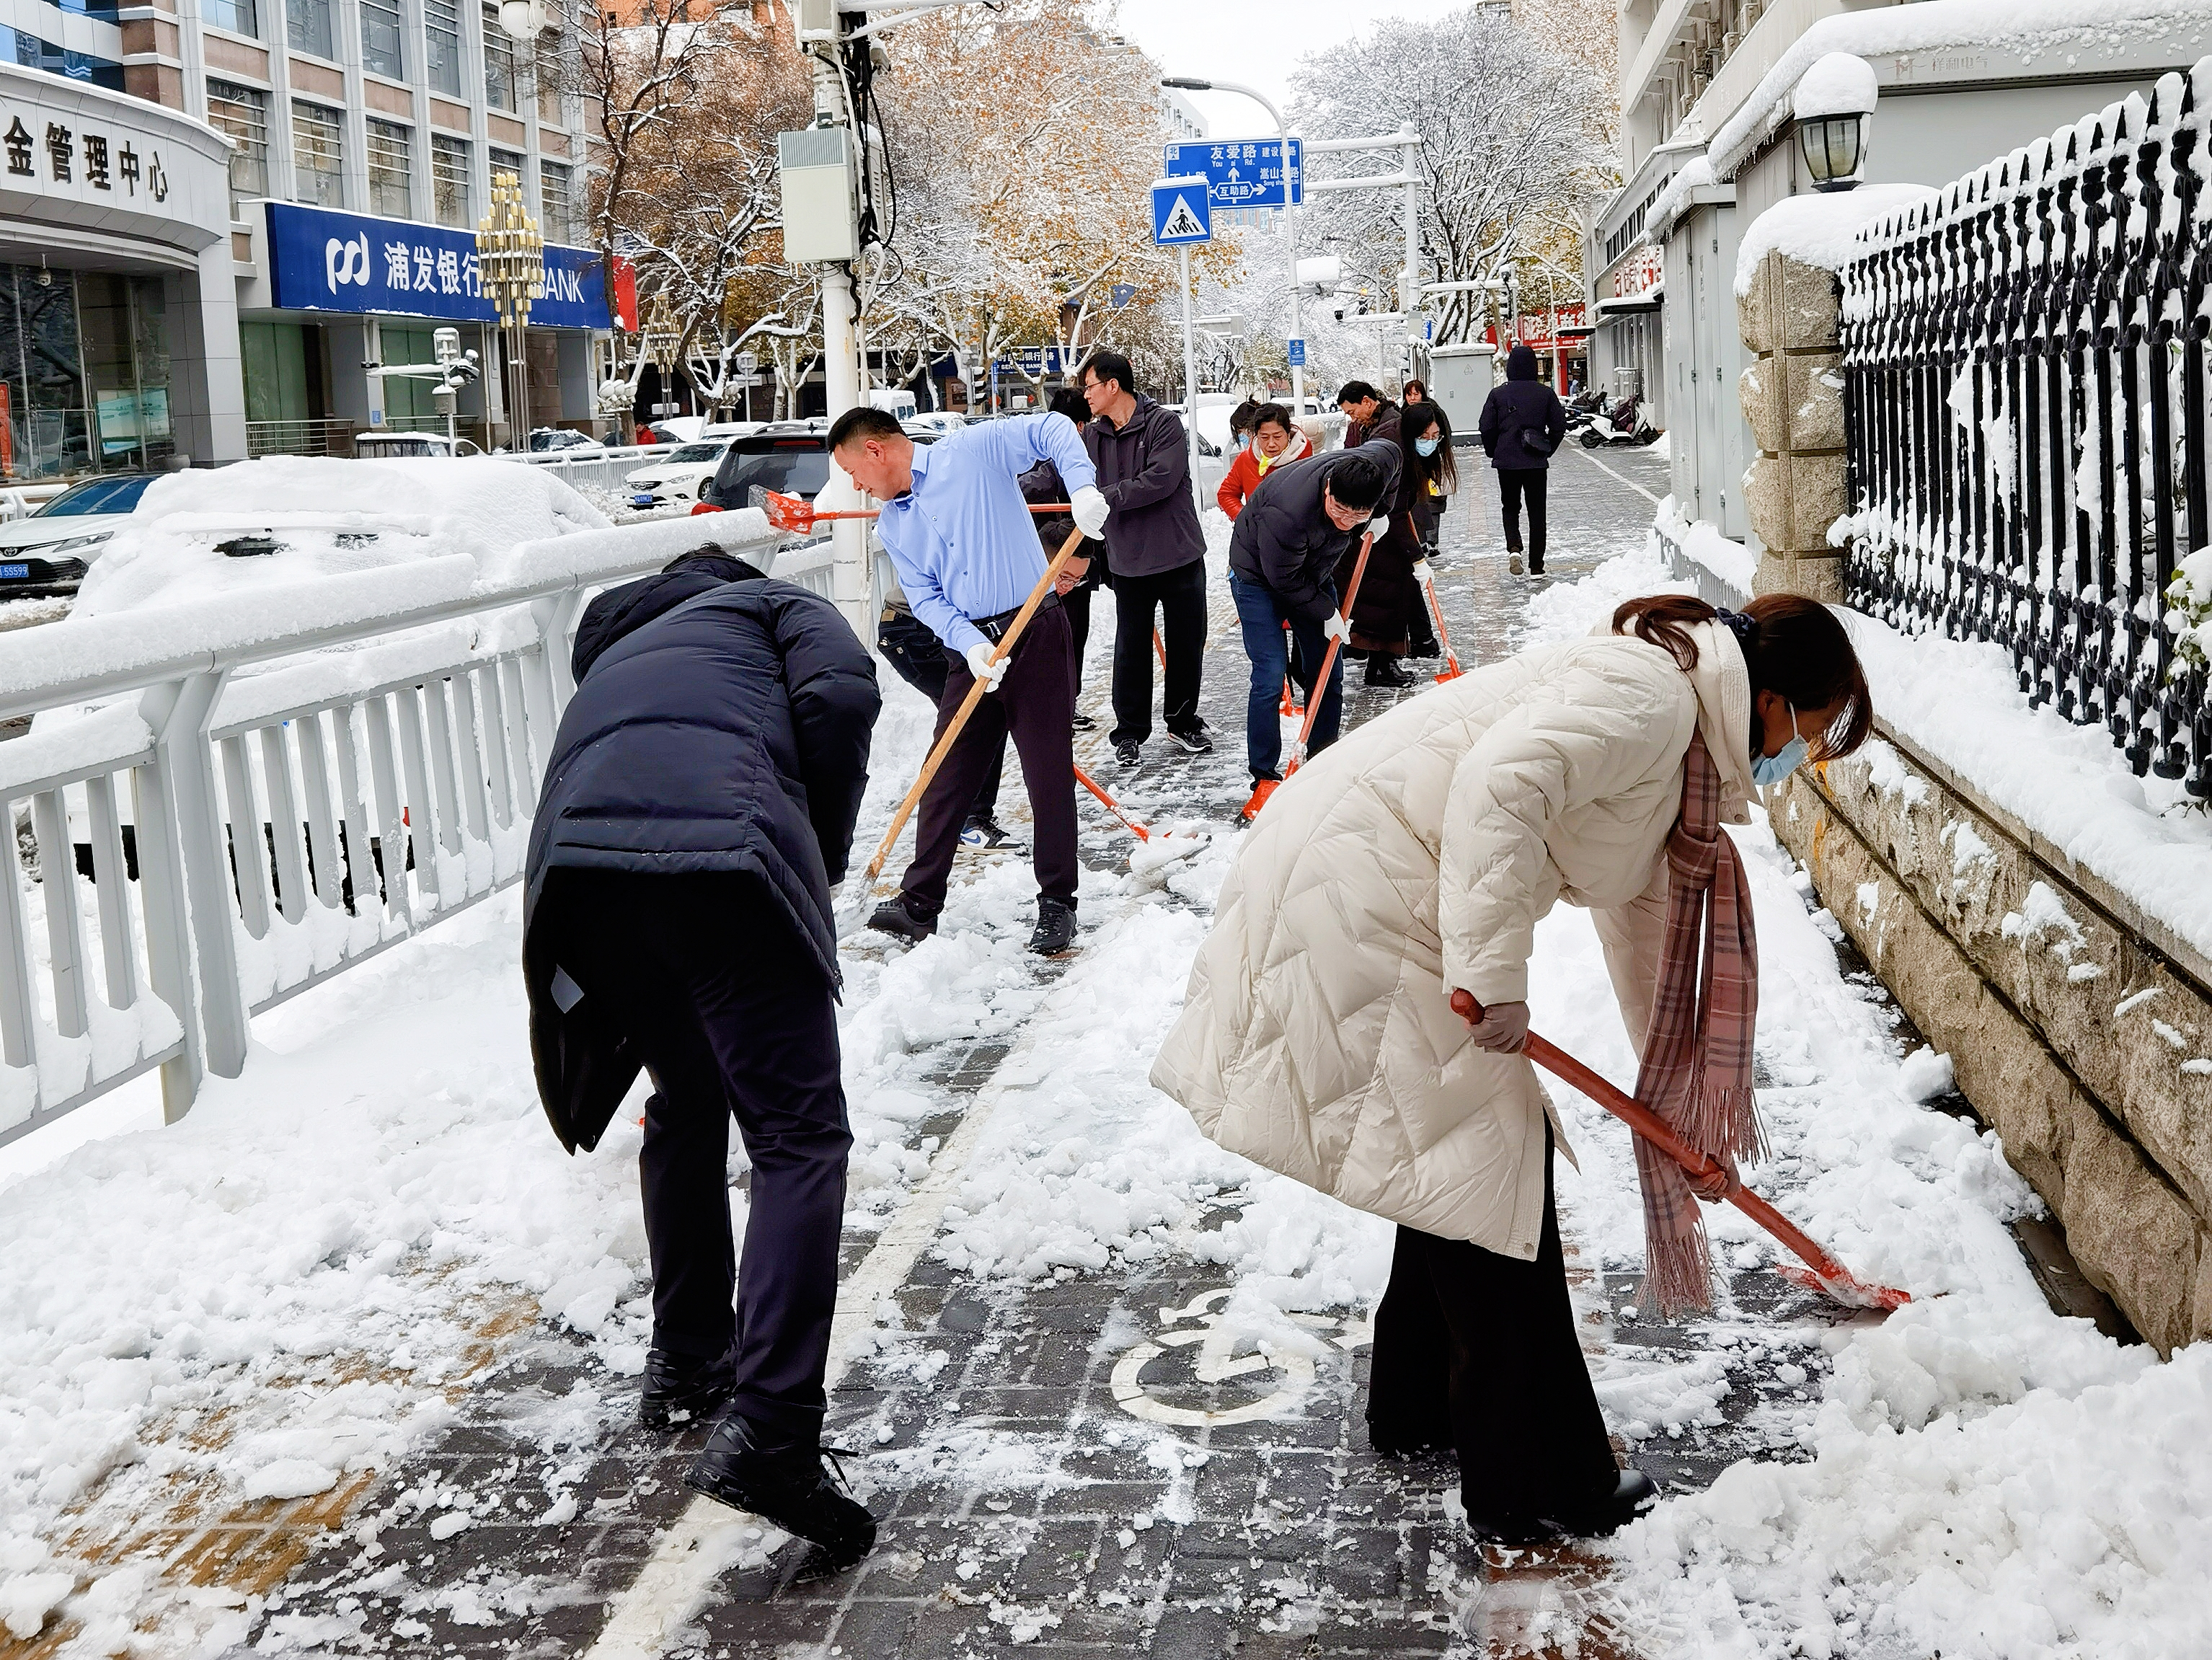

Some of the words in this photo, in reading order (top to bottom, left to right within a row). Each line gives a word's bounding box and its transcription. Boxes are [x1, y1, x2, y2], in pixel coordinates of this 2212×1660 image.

[2, 115, 168, 203] 金管理中心
[1211, 144, 1257, 159] 友爱路
[1219, 185, 1249, 196] 互助路
[384, 241, 483, 299] 浦发银行
